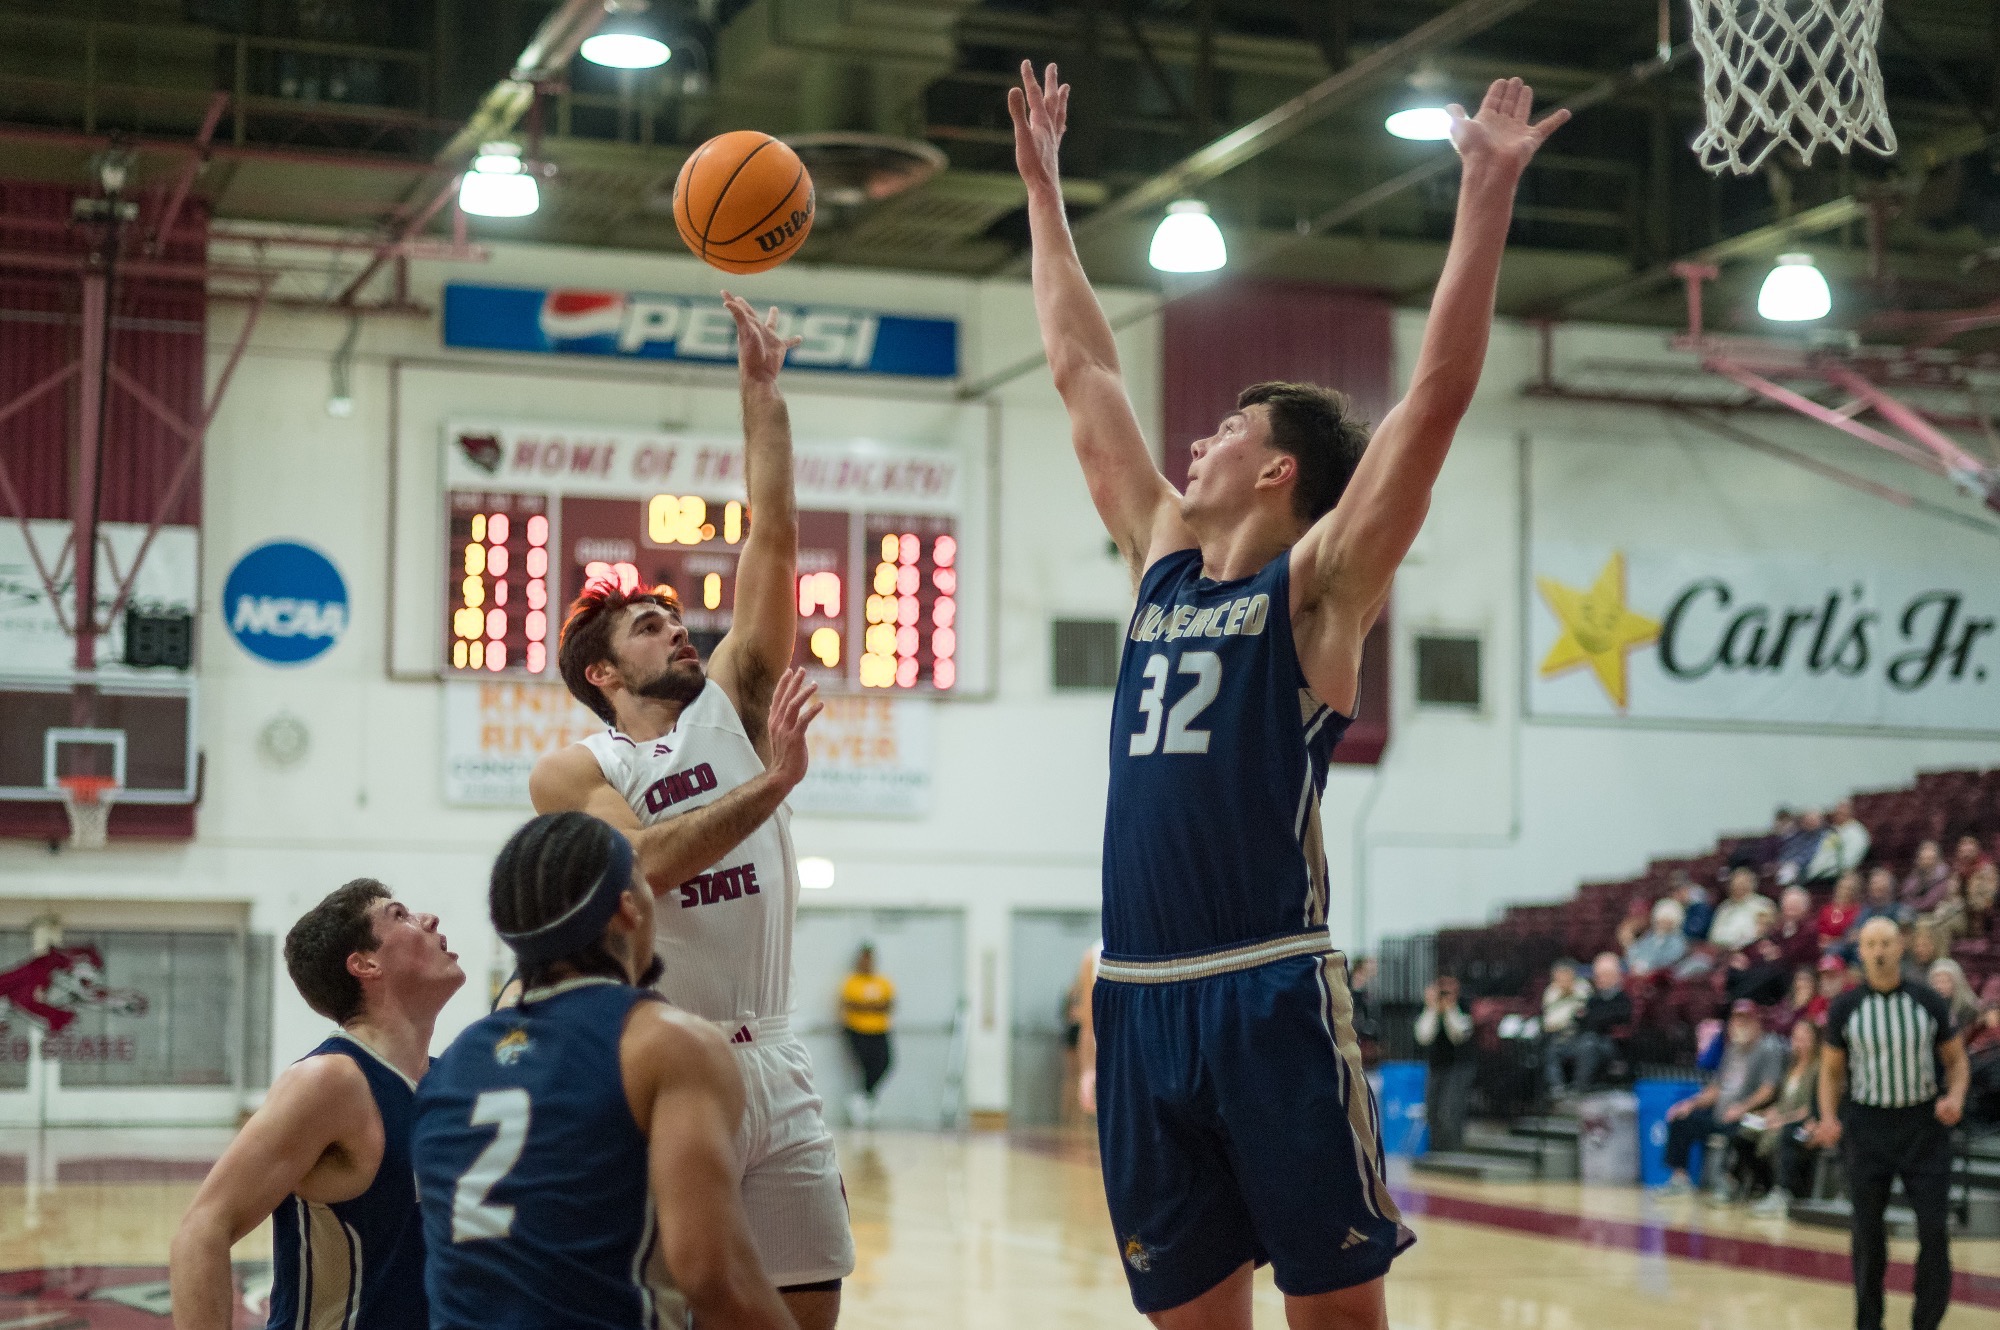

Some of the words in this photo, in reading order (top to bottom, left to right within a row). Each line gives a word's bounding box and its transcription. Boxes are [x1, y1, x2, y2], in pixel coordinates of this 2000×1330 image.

[511, 436, 615, 478] HOME
[632, 441, 678, 480] OF
[233, 594, 348, 640] NCAA
[1656, 576, 1879, 683] Carl's
[1885, 587, 1996, 694] Jr.
[1128, 650, 1223, 757] 32
[644, 762, 718, 815] CHICO
[679, 862, 760, 909] STATE
[451, 1087, 532, 1244] 2
